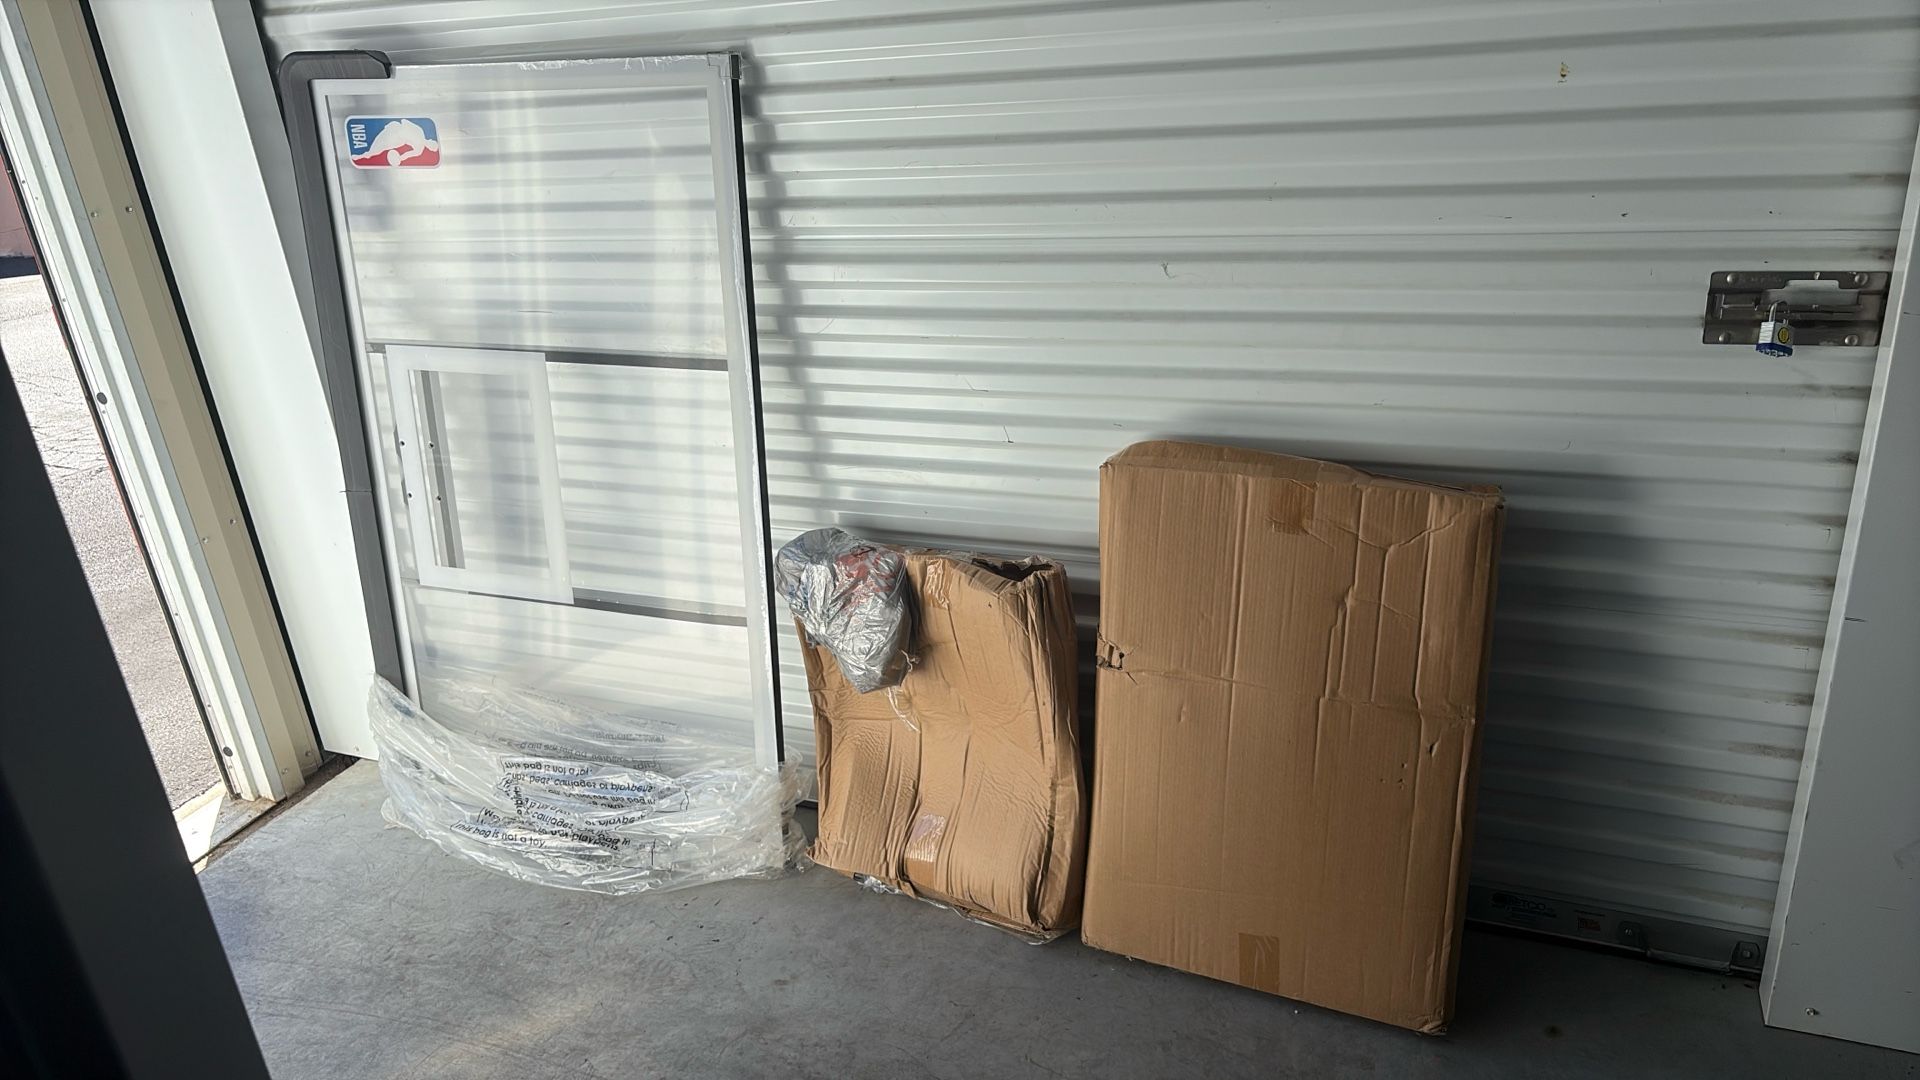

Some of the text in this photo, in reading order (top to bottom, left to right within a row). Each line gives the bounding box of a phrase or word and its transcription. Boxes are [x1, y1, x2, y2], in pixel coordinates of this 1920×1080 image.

[350, 124, 368, 149] NBA
[473, 828, 491, 838] bag
[492, 829, 500, 838] is
[529, 836, 547, 849] toy.
